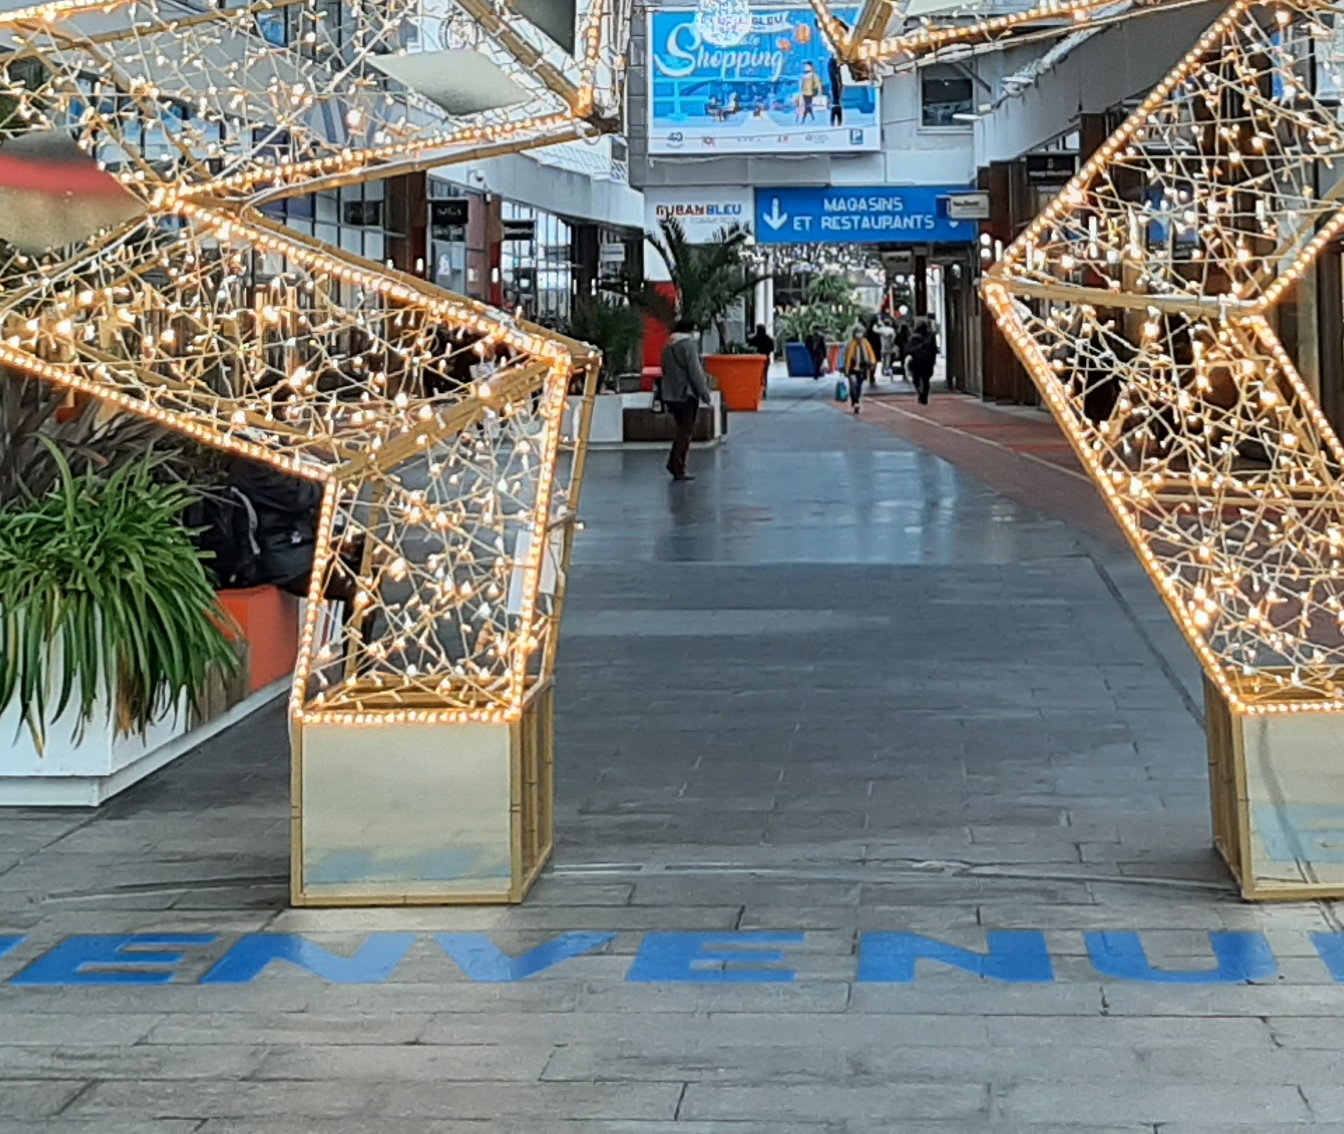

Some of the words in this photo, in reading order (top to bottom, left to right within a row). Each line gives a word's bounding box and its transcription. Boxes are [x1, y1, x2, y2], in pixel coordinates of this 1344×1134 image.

[655, 22, 783, 82] Shopping
[823, 197, 903, 212] MAGASINS
[793, 217, 812, 231] ET
[821, 215, 935, 231] RESTAURANTS
